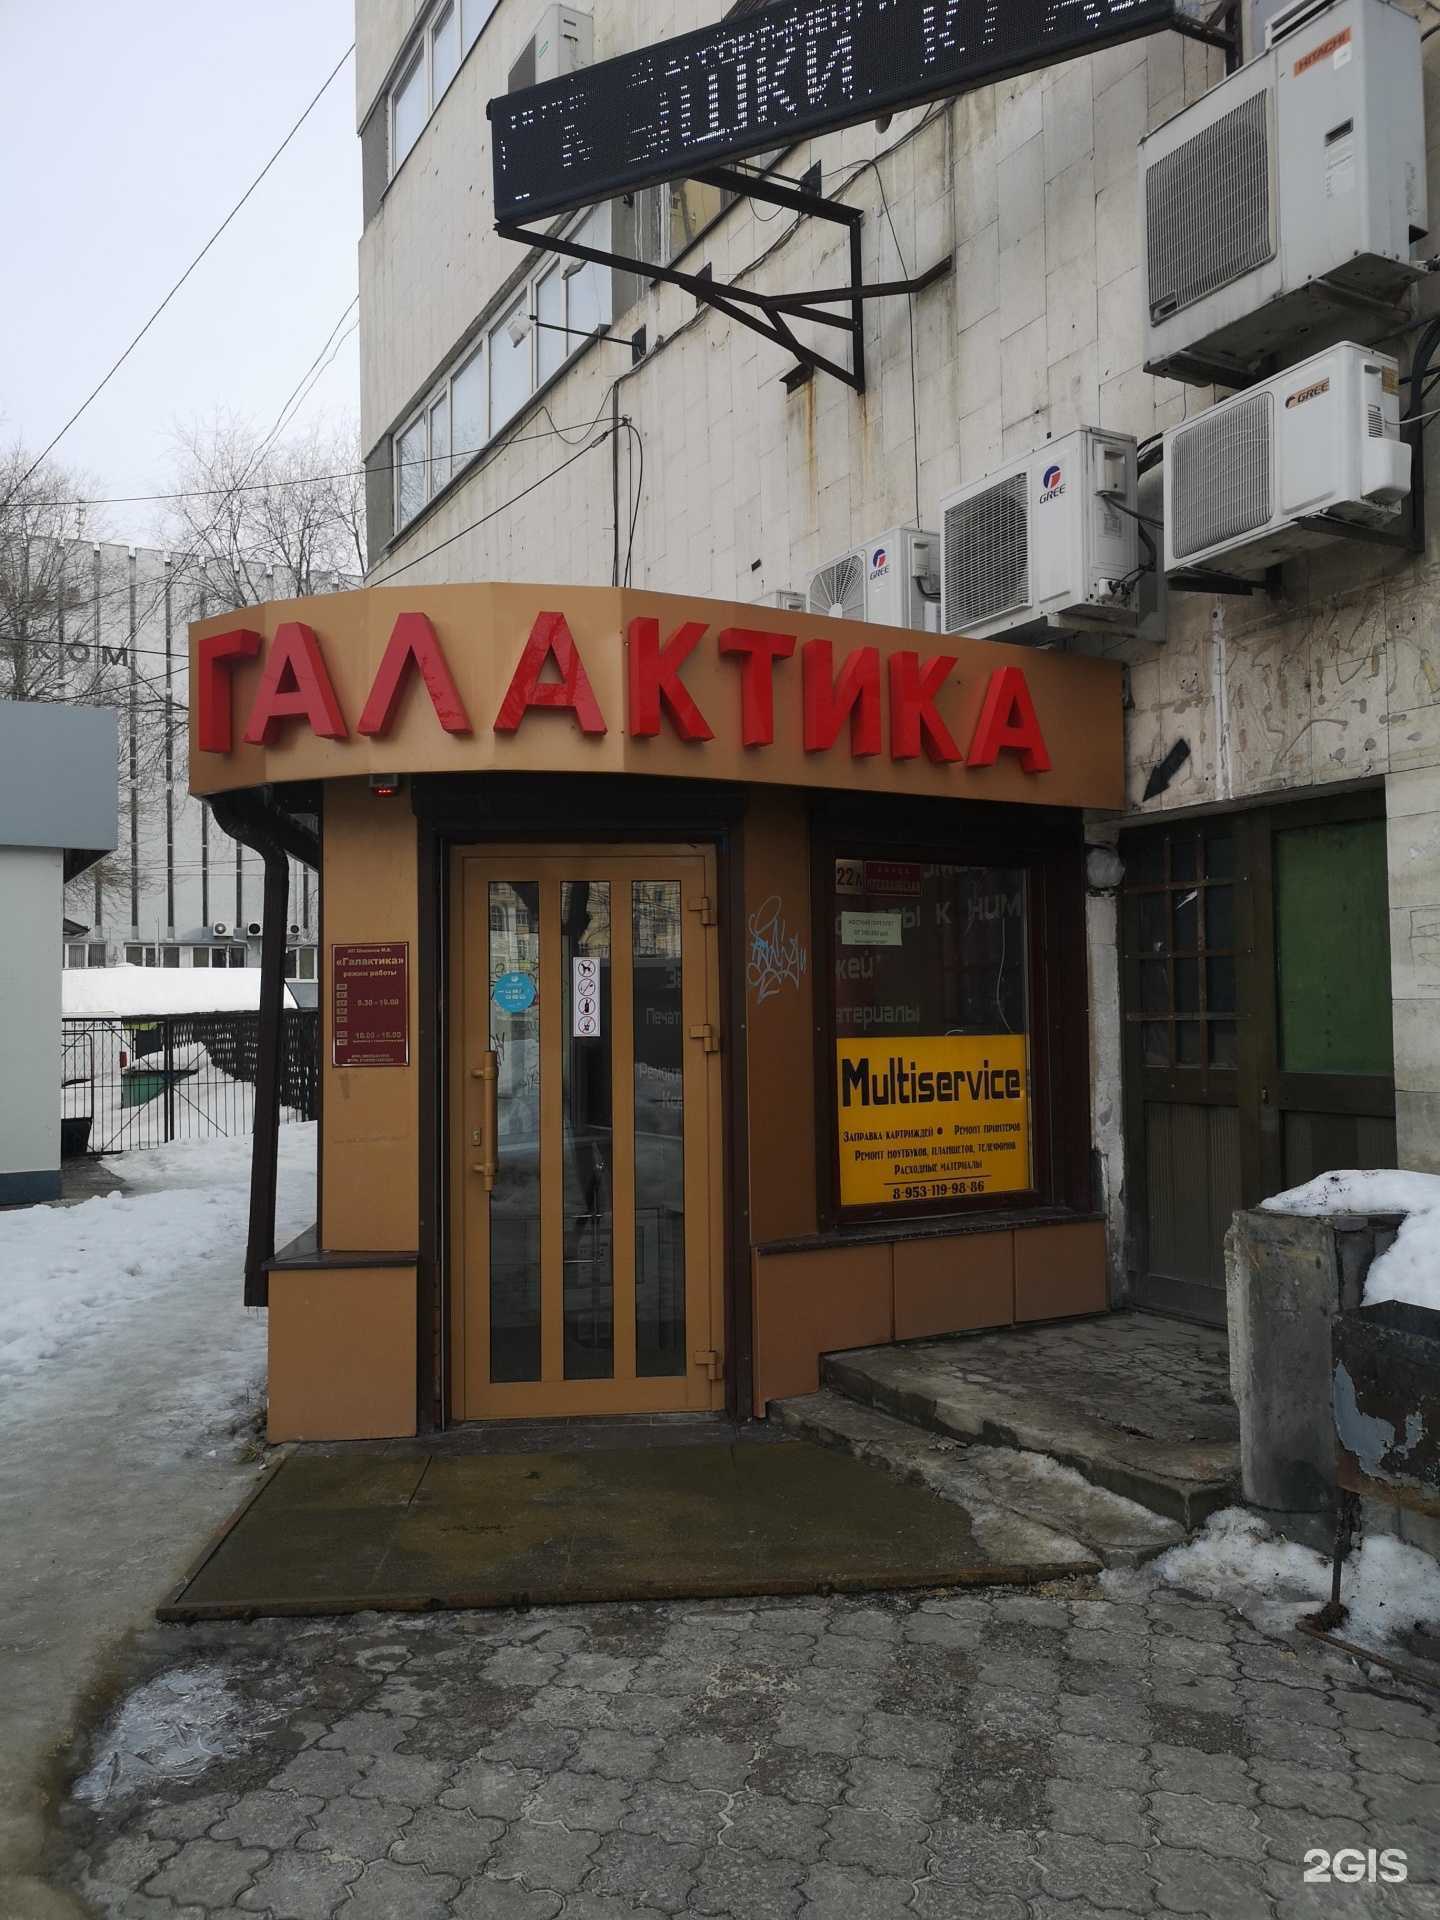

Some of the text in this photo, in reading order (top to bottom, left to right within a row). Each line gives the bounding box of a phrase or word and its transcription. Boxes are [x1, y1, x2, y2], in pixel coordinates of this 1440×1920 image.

[1298, 380, 1329, 403] GREE
[1040, 483, 1066, 504] GREE
[198, 610, 1052, 774] ГАЛАКТИКА
[842, 1056, 1021, 1107] Multiservice
